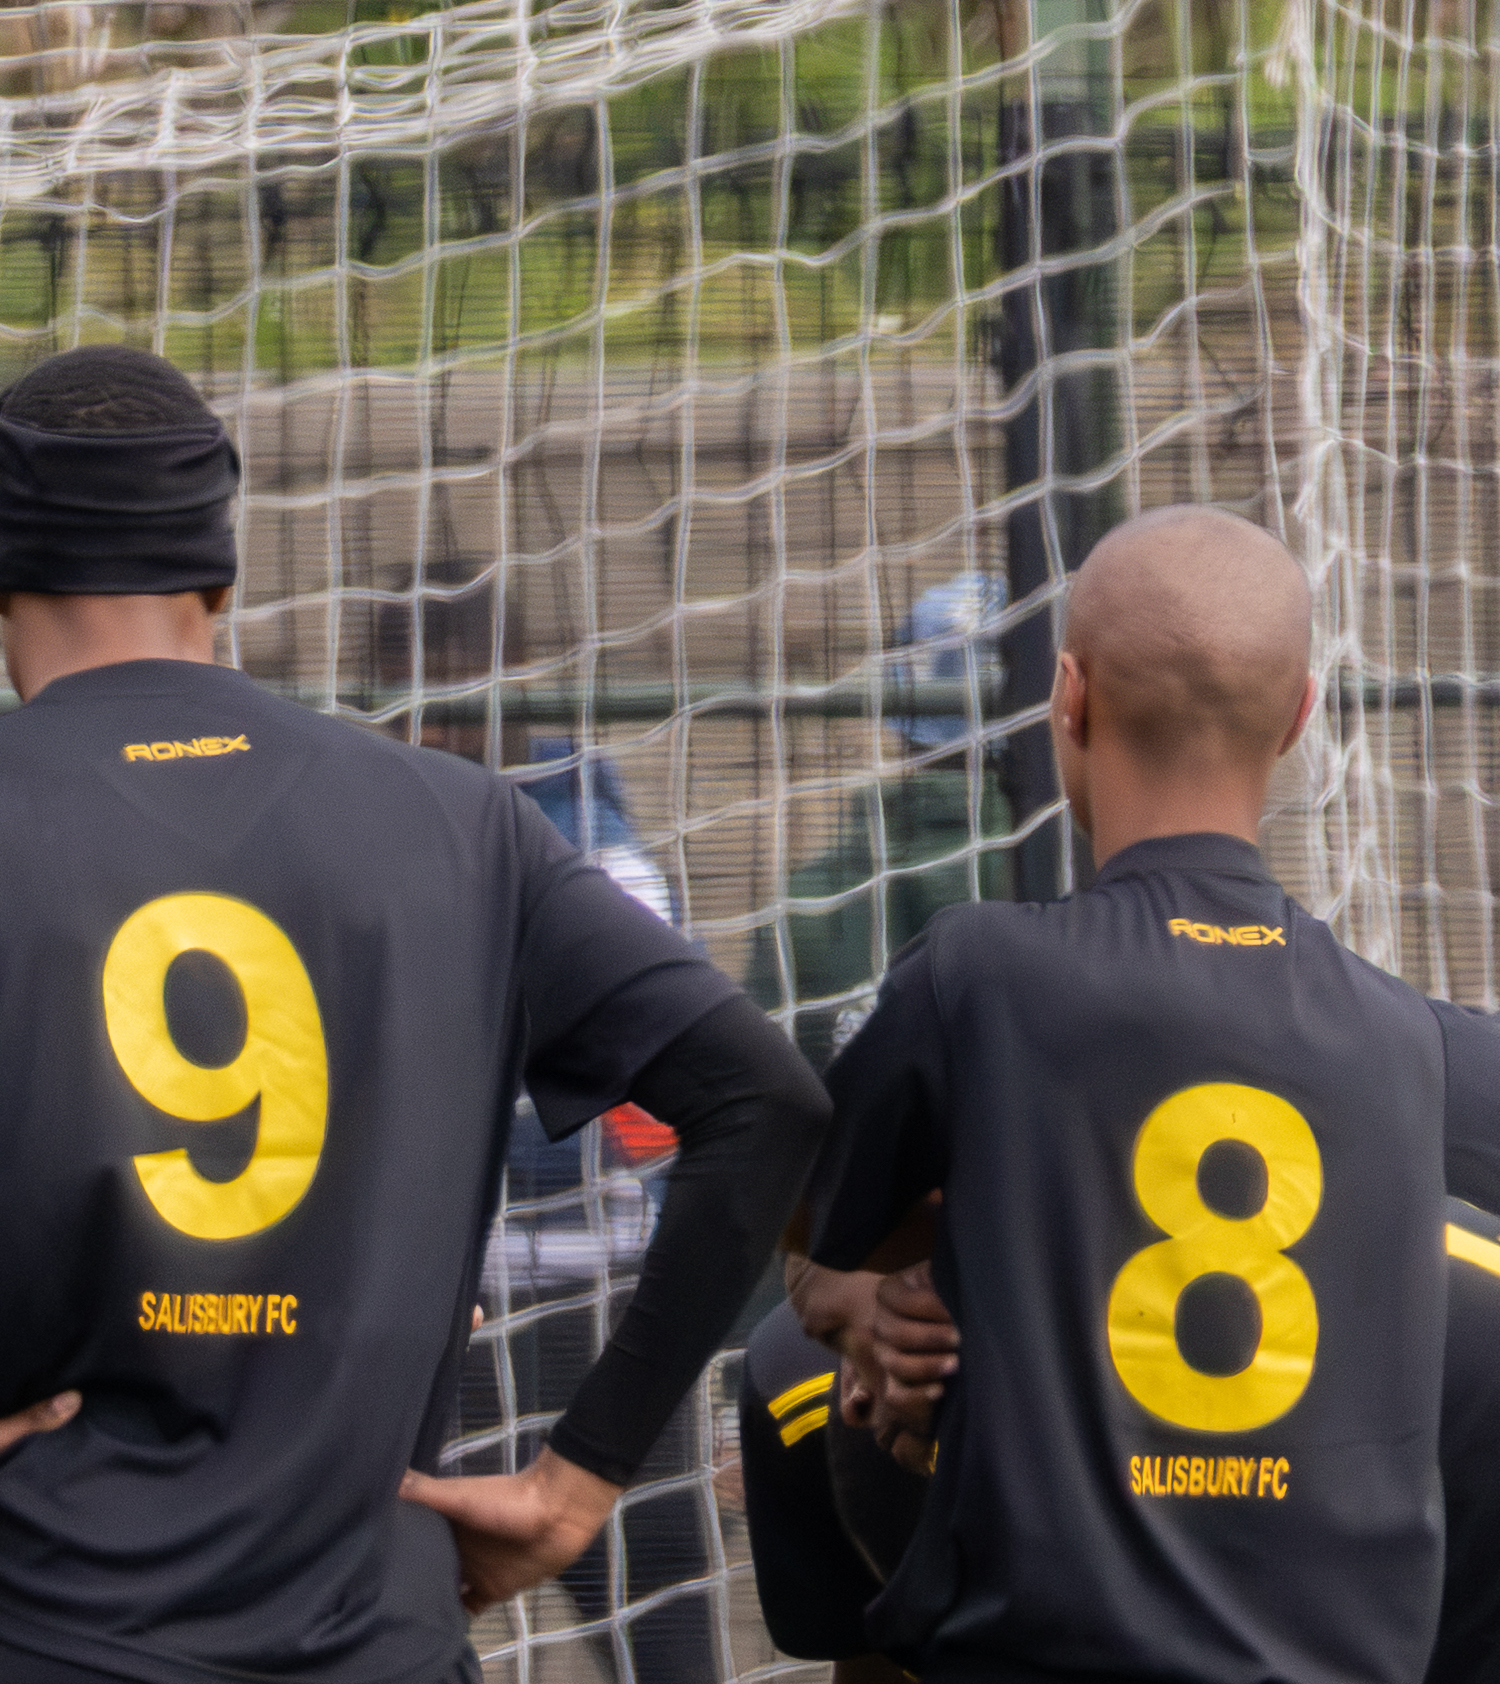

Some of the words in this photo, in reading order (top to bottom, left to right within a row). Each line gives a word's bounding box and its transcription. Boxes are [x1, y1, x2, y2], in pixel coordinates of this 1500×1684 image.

[124, 734, 251, 762] RONEX
[1168, 918, 1286, 946] RONEX
[102, 891, 329, 1241] 9
[1106, 1082, 1324, 1433] 8
[138, 1290, 263, 1334] SALISBURY
[265, 1293, 298, 1334] FC
[1130, 1455, 1256, 1496] SALISBURY
[1257, 1456, 1290, 1499] FC
